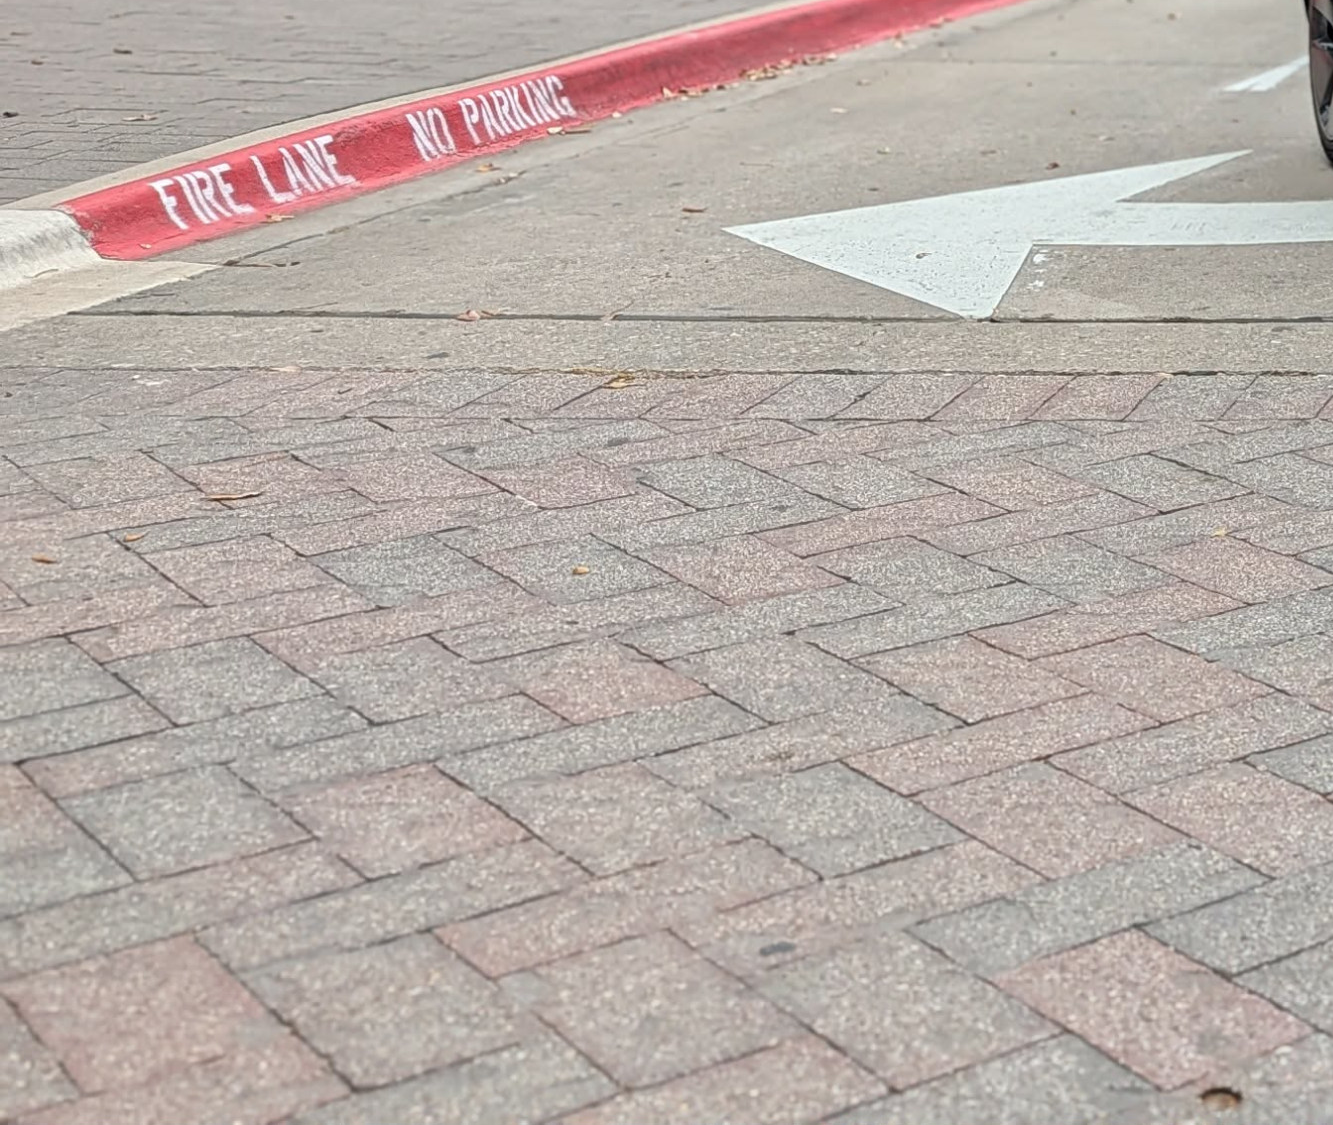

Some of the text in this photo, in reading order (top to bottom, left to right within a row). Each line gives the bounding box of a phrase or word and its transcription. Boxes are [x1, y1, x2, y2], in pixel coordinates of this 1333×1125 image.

[405, 75, 577, 162] NO PARKING
[146, 134, 357, 230] FIRE LANE
